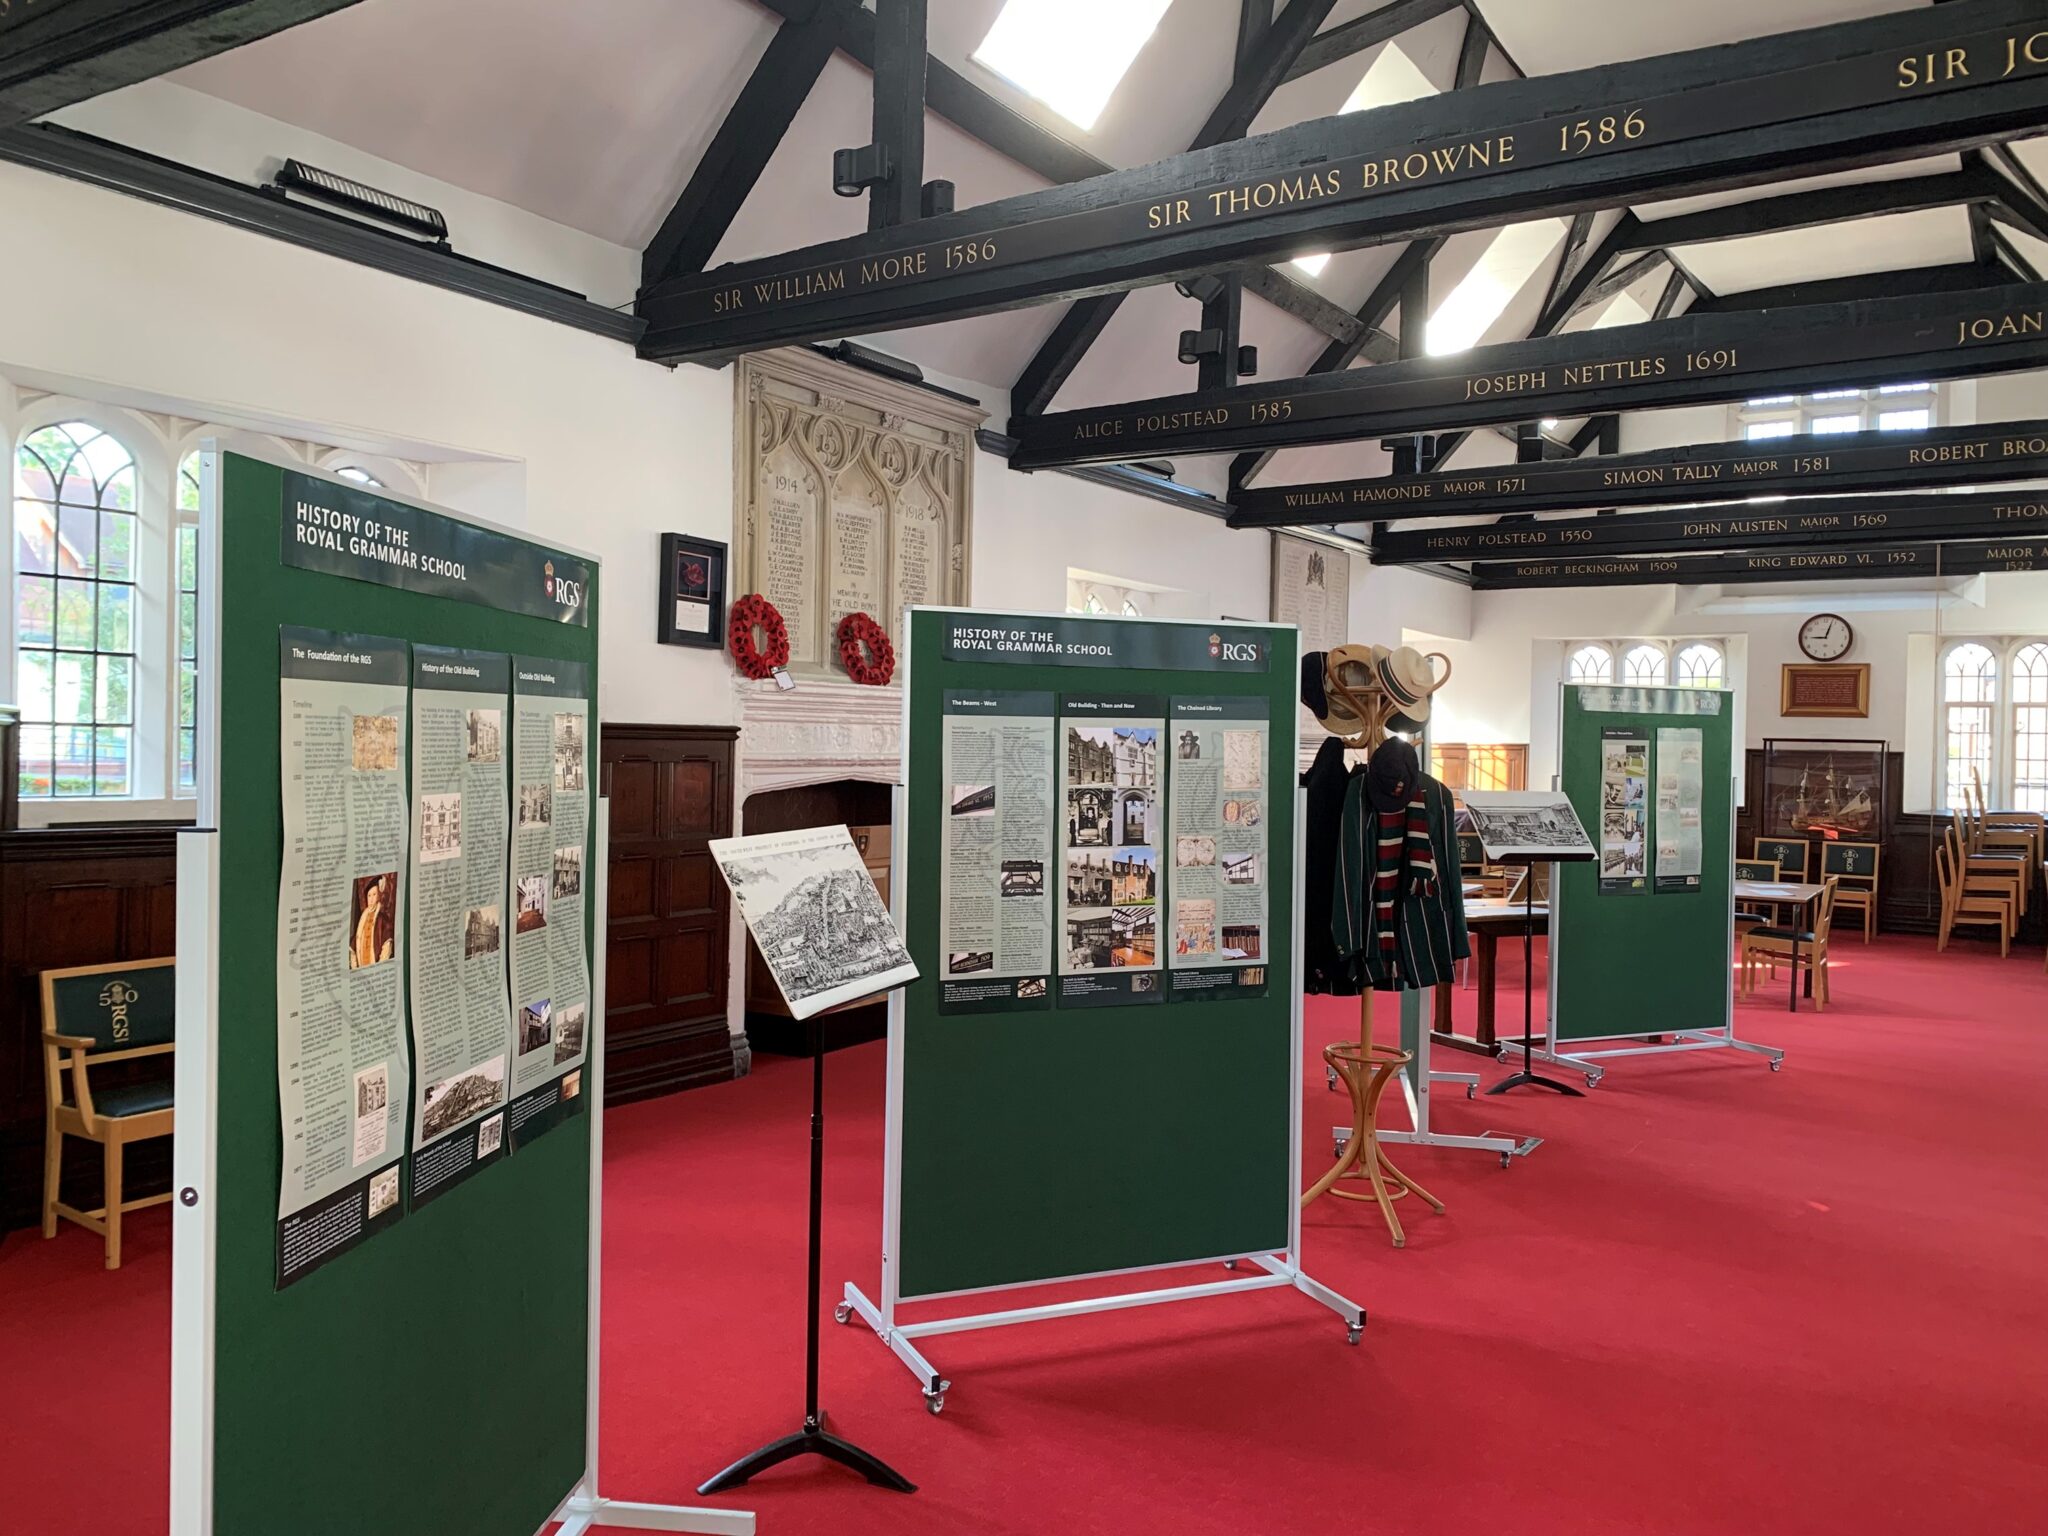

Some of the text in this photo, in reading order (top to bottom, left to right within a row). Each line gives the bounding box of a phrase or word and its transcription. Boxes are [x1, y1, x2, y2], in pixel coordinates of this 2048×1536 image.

[1897, 48, 1970, 88] SIR
[1148, 108, 1646, 229] SIR THOMAS BROWNE 1586
[714, 237, 997, 313] SIR WILLIAM MORE 1586
[1958, 311, 2043, 345] JOAN
[1465, 349, 1738, 400] JOSEPH NETTLES 1691
[1074, 400, 1293, 440] ALICE POLSTEAD 1585
[1909, 438, 2048, 463] ROBERT BRO
[1604, 468, 1664, 485] SIMON
[1672, 465, 1723, 481] TALLY
[1794, 457, 1830, 473] 1581
[775, 475, 797, 494] 1914
[1285, 491, 1345, 507] WILLIAM
[1353, 485, 1432, 502] HAMONDE
[1497, 478, 1527, 494] 1571
[297, 501, 409, 547] HISTORY OF THE
[1683, 523, 1721, 537] JOHN
[1729, 519, 1788, 534] AUSTEN
[1853, 513, 1887, 528] 1569
[296, 523, 467, 581] ROYAL GRAMMAR SCHOOL
[1427, 535, 1471, 548] HENRY
[1478, 532, 1547, 545] POLSTEAD
[1987, 547, 2033, 559] MAIOR
[1517, 566, 1558, 576] ROBERT
[1565, 562, 1639, 575] BECKINGHAM
[1748, 557, 1781, 568] KING
[1790, 554, 1848, 567] EDWARD
[1888, 552, 1916, 563] 1552
[555, 576, 580, 608] RGS
[953, 627, 1054, 643] HISTORY OF THE
[953, 638, 1113, 656] ROYAL GRAMMAR SCHOOL
[292, 648, 372, 665] The Foundation of the RGS
[1222, 643, 1257, 662] RGS
[422, 663, 439, 675] History
[111, 1004, 129, 1039] RGS
